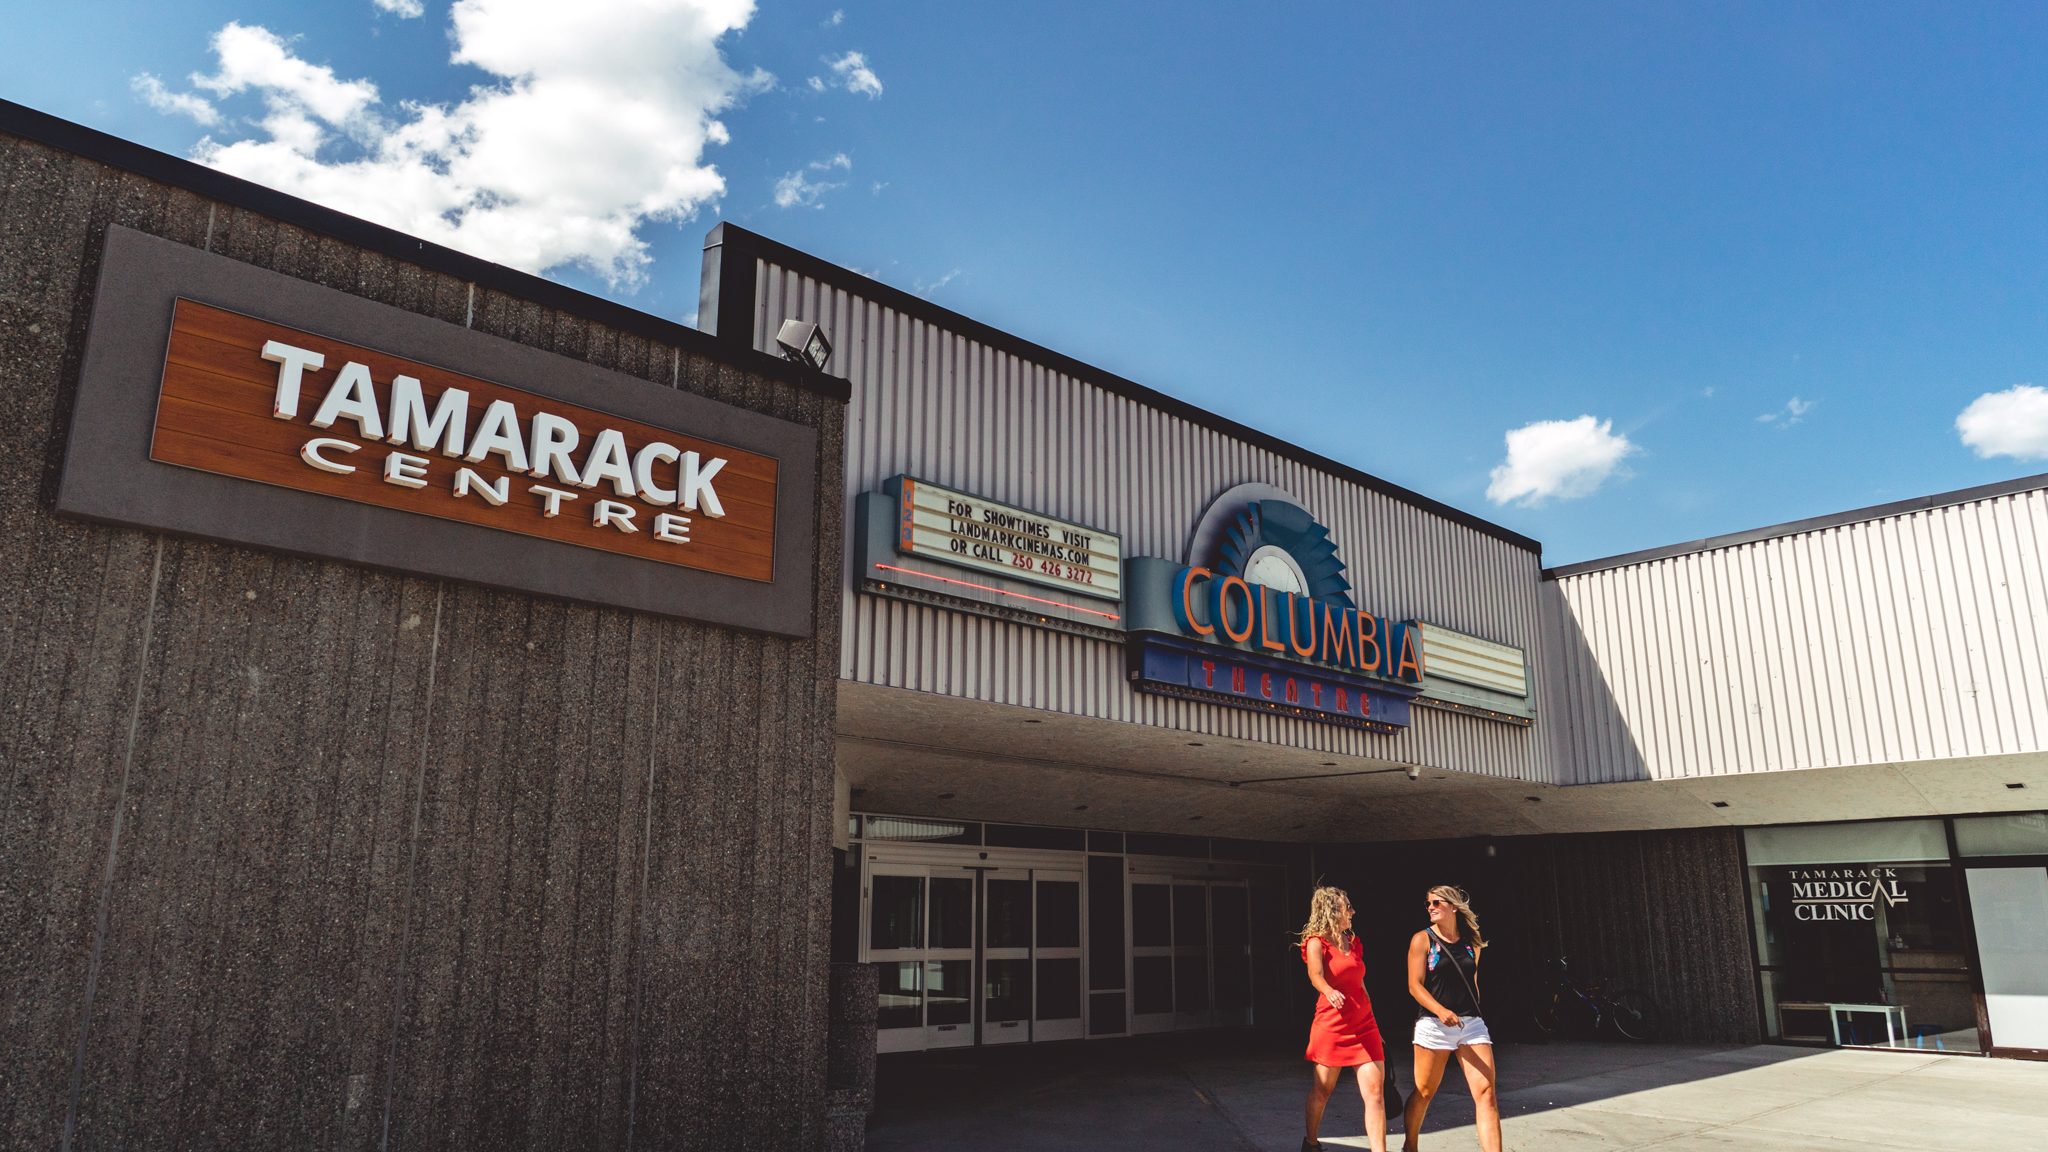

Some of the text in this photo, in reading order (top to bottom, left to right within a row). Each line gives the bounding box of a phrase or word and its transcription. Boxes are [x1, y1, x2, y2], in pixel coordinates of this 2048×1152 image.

[261, 340, 728, 518] TAMARACK
[300, 437, 692, 544] CENTRE
[905, 508, 912, 521] 2
[949, 500, 1091, 549] FOR SHOWTIMES VISIT
[951, 519, 1089, 566] LANDMARKCINEMAS.COM
[951, 539, 1092, 584] OR CALL 250 426 3272
[1175, 566, 1423, 683] COLUMBIA
[1202, 660, 1370, 717] THEATRE
[1789, 868, 1897, 879] TAMARACK
[1792, 880, 1907, 898] MEDICAL
[1794, 904, 1875, 920] CLINIC
